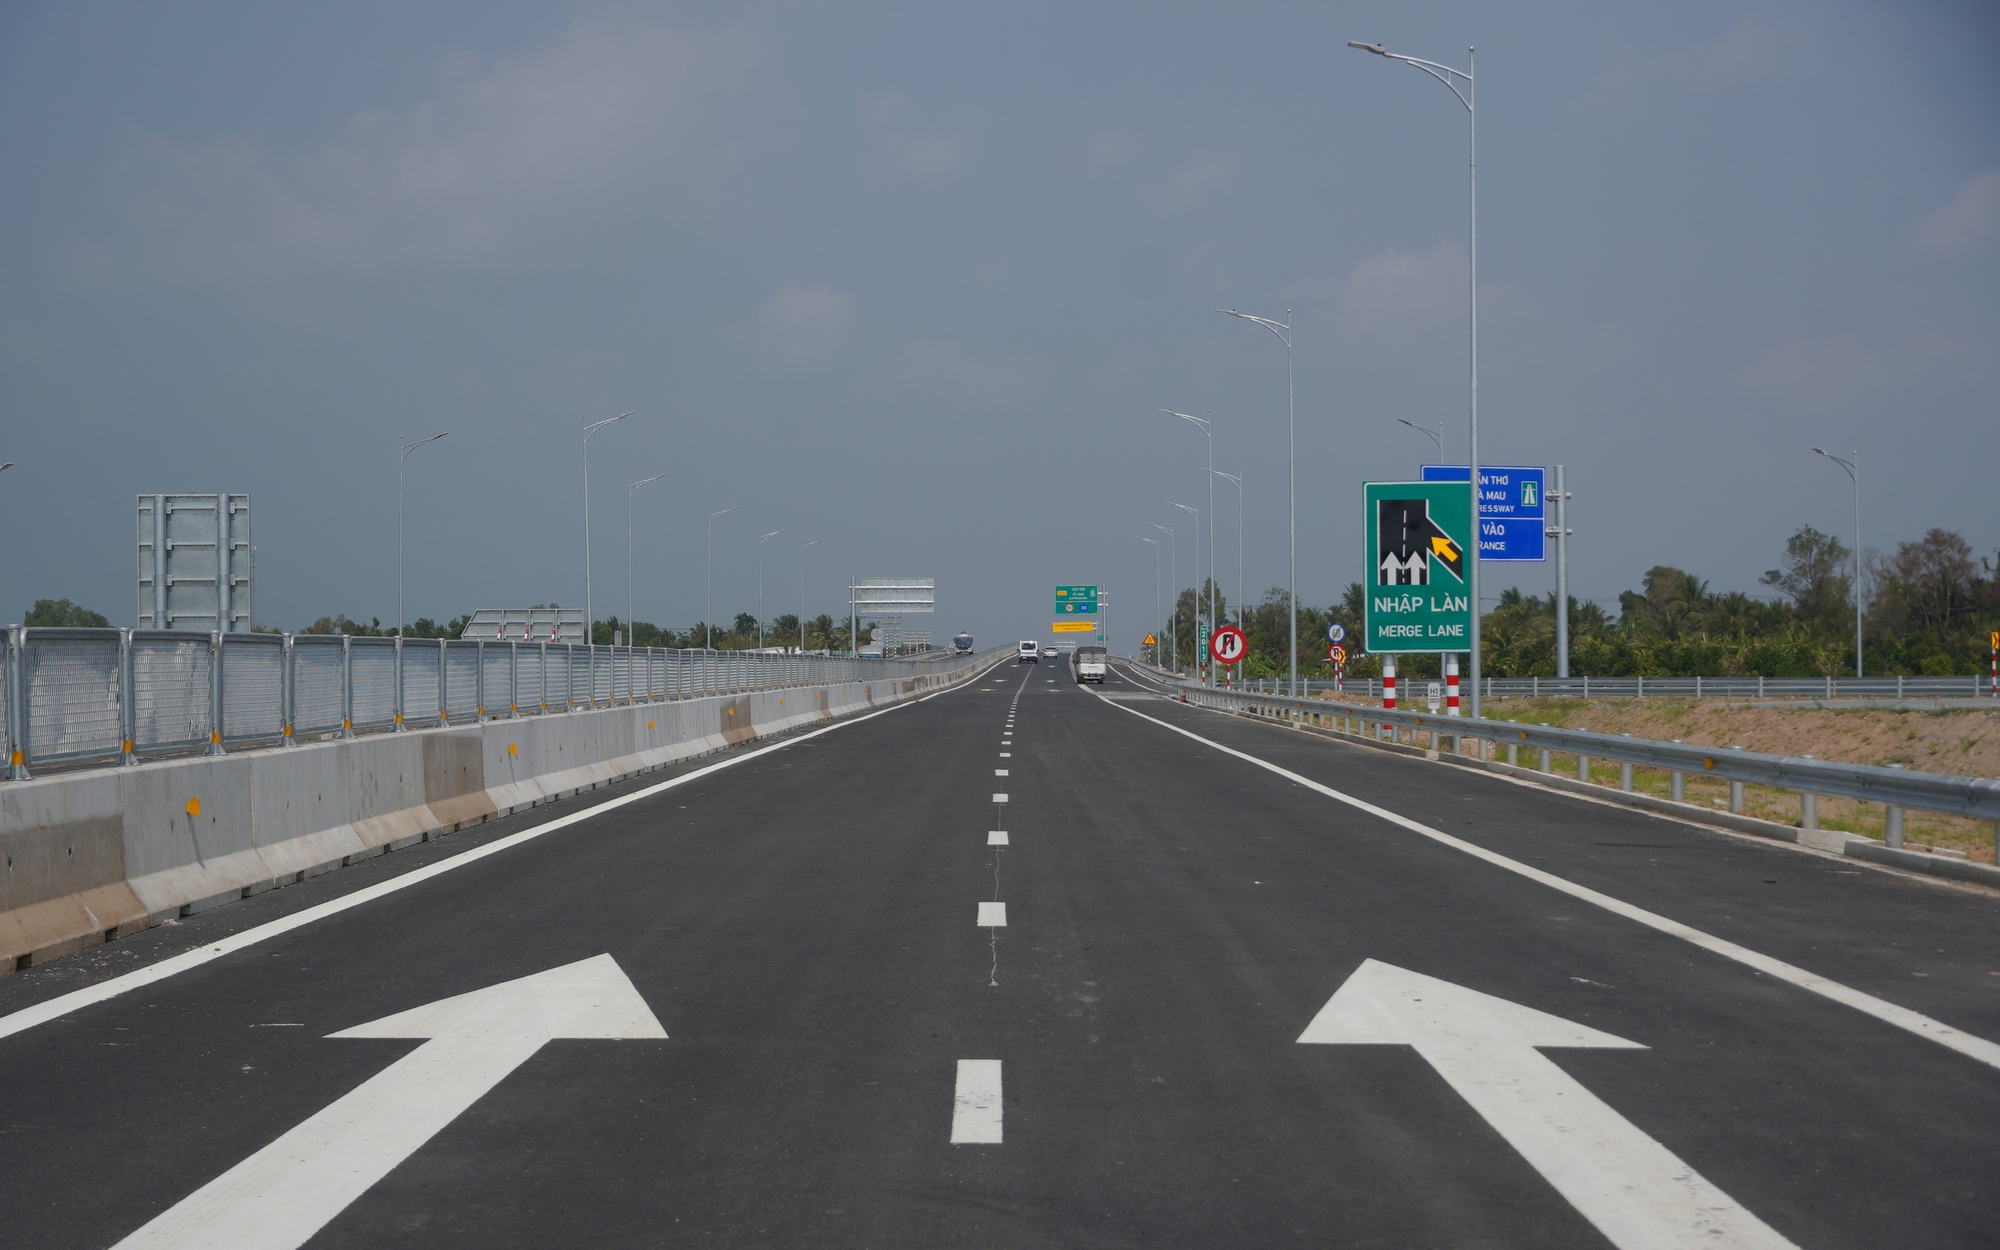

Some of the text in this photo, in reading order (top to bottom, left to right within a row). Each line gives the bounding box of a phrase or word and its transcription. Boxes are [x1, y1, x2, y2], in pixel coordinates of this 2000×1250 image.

[1490, 474, 1509, 485] THƠ
[1478, 488, 1506, 500] À MAU
[1478, 504, 1515, 513] RESSWAY
[1482, 521, 1505, 536] VÀO
[1478, 541, 1506, 550] RANCE
[1374, 592, 1468, 615] NHẬP LÀN
[1378, 624, 1464, 638] MERGE LANE
